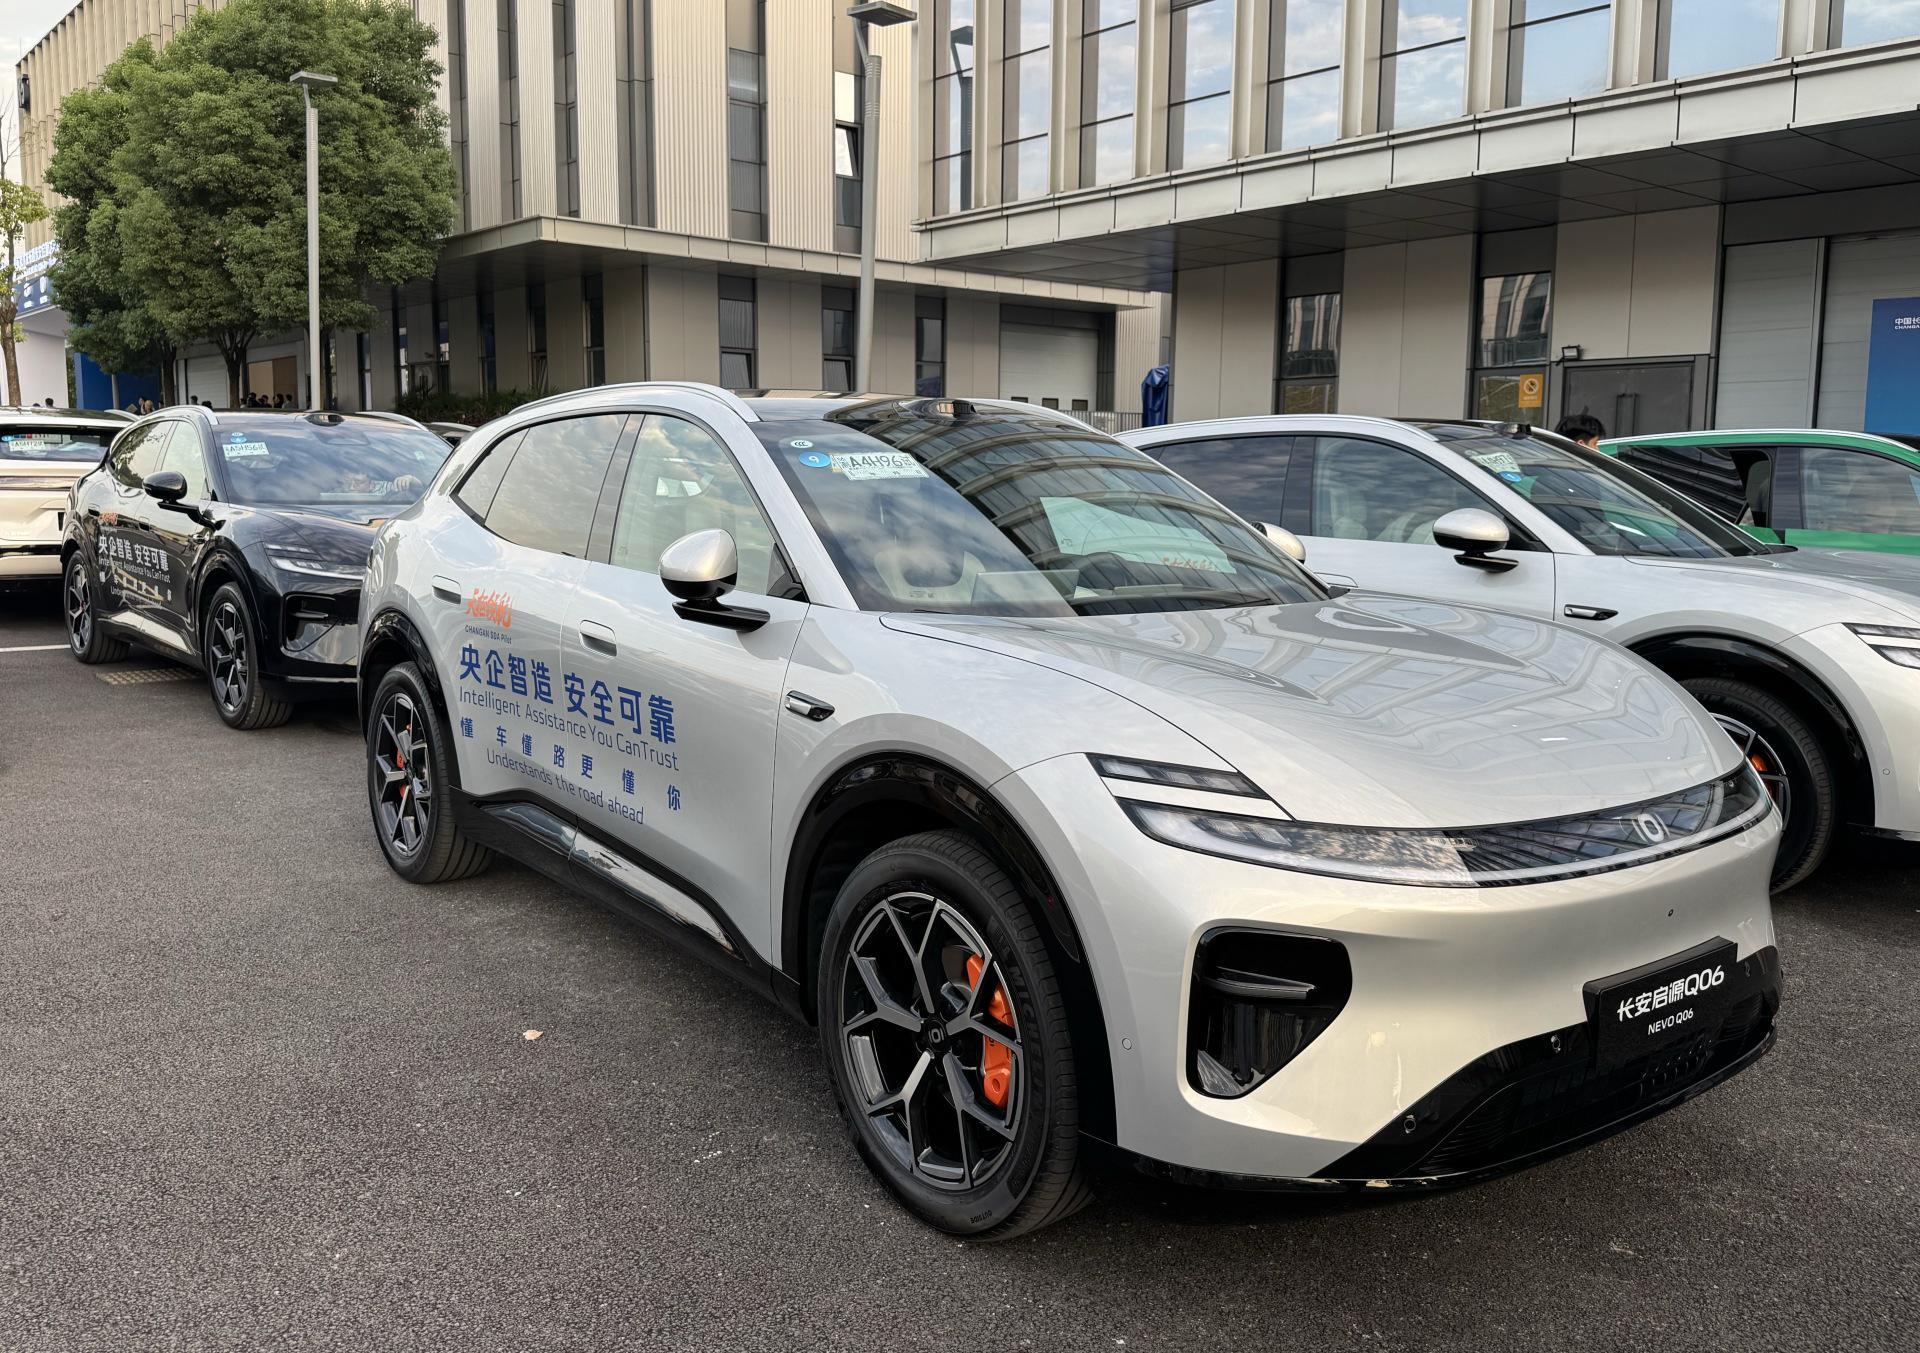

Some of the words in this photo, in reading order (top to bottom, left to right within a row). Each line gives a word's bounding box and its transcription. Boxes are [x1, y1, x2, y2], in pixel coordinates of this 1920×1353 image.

[134, 544, 169, 572] 安全可靠
[464, 624, 490, 638] CHANGAN
[459, 643, 554, 705] 央企智造
[563, 672, 677, 745] 安全可靠
[459, 686, 521, 718] Intelligent
[525, 703, 587, 739] Assistance
[588, 723, 614, 749] You
[615, 733, 680, 772] CanTrust
[486, 748, 552, 786] Understands
[556, 774, 576, 796] the
[578, 786, 604, 808] road
[607, 797, 645, 825] ahead
[1616, 965, 1725, 1022] 长安启源Q06
[1647, 1015, 1675, 1035] NEVO
[1675, 1008, 1694, 1024] Q06
